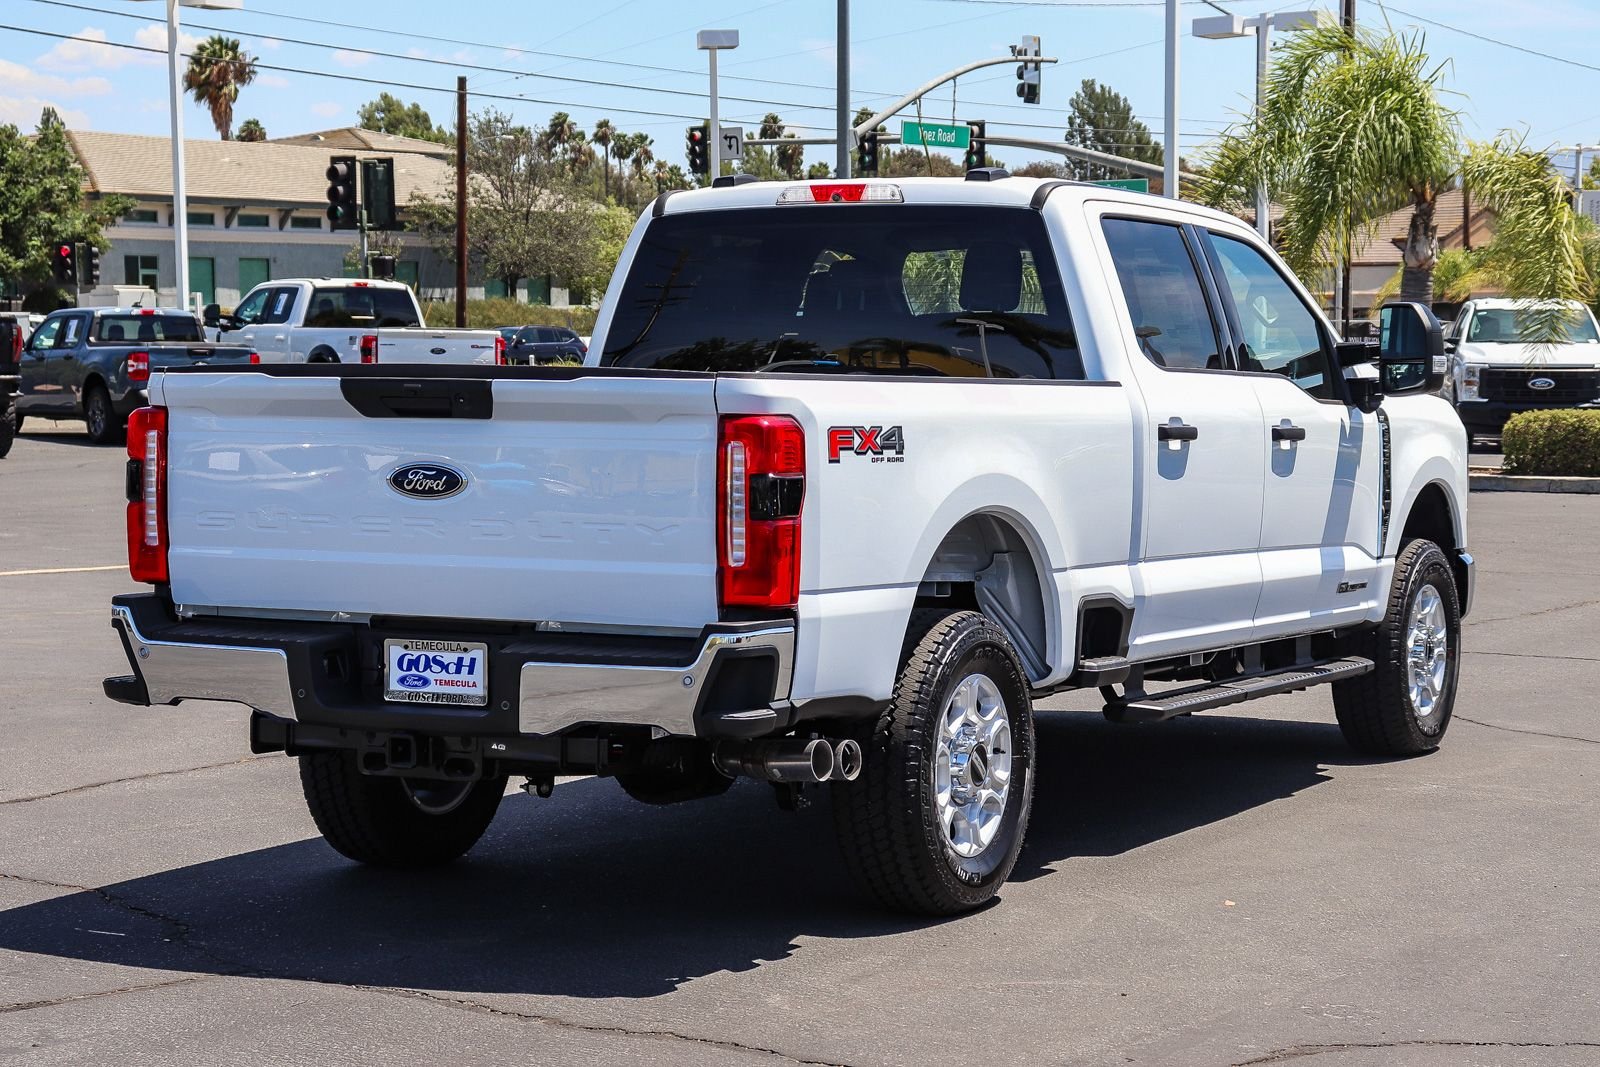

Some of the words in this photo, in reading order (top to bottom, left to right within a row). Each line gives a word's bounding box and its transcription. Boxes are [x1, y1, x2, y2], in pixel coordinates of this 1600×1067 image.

[937, 128, 956, 143] Road
[827, 426, 905, 464] FX4
[871, 456, 885, 464] OFF
[403, 469, 447, 491] Ford
[408, 640, 463, 652] TEMECULA
[433, 678, 478, 688] TEMECULA
[440, 693, 464, 704] FORD
